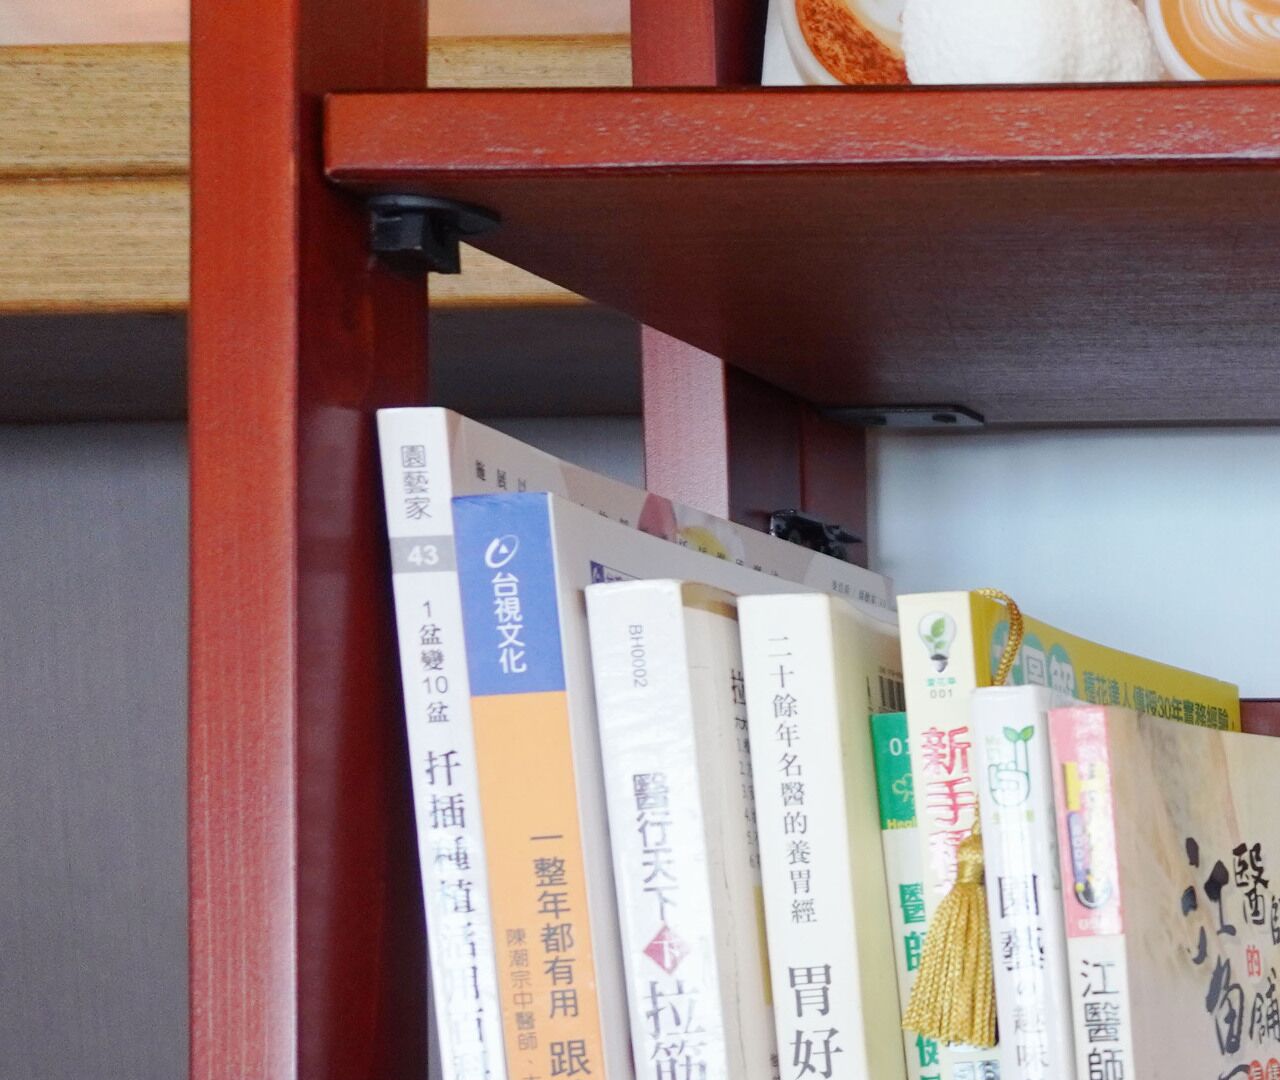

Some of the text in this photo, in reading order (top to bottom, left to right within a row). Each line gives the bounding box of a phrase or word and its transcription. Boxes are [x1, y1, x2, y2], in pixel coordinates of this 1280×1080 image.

[401, 445, 433, 521] 園藝家
[407, 544, 440, 567] 43
[491, 572, 527, 675] 台視文化
[628, 624, 649, 690] BH0002
[766, 635, 818, 925] 二十餘年名醫的養胃經
[633, 771, 679, 921] 醫行天下
